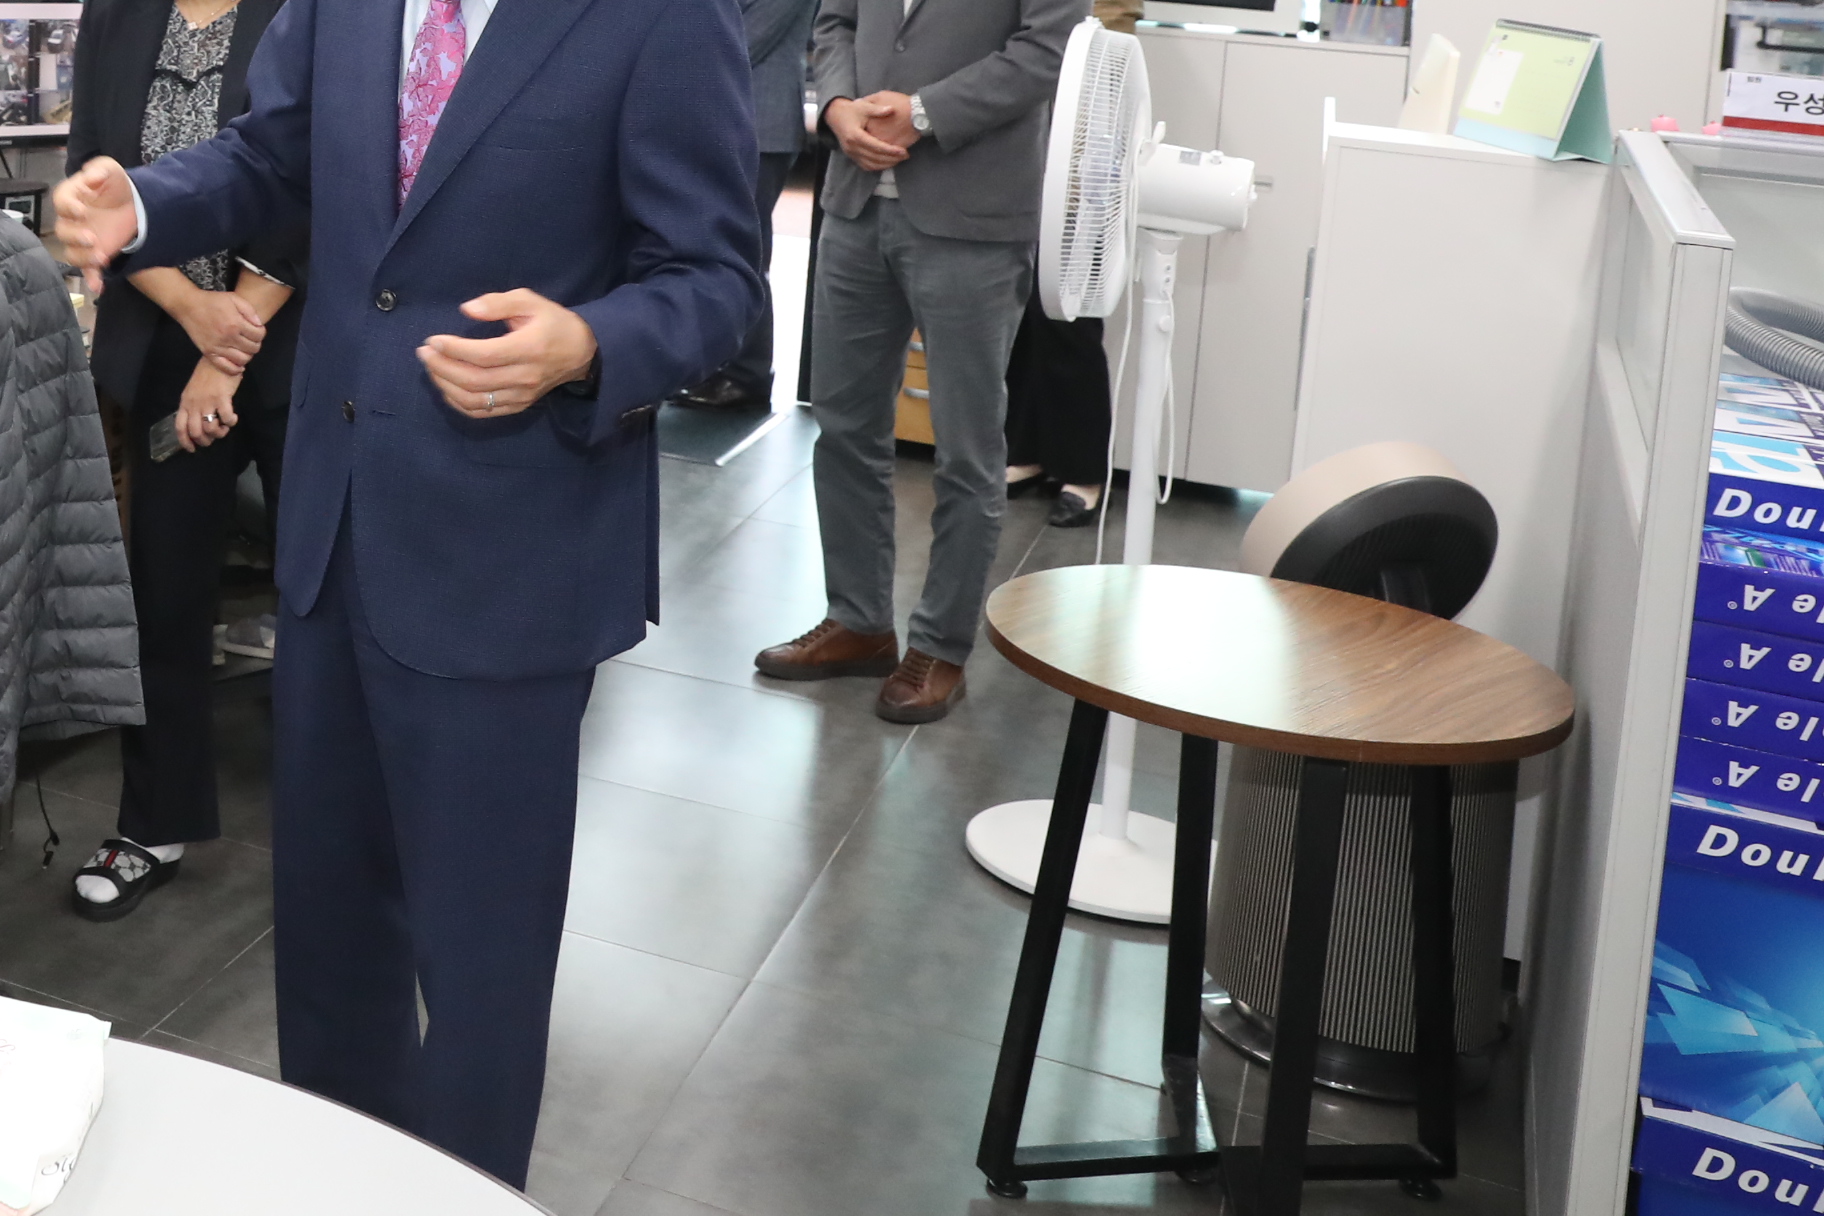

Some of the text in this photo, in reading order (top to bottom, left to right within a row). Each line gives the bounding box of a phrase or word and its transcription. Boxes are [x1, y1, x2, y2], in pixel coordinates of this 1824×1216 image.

[1713, 487, 1824, 531] Dou
[1696, 823, 1824, 882] Dou
[1691, 1147, 1824, 1214] Dou
